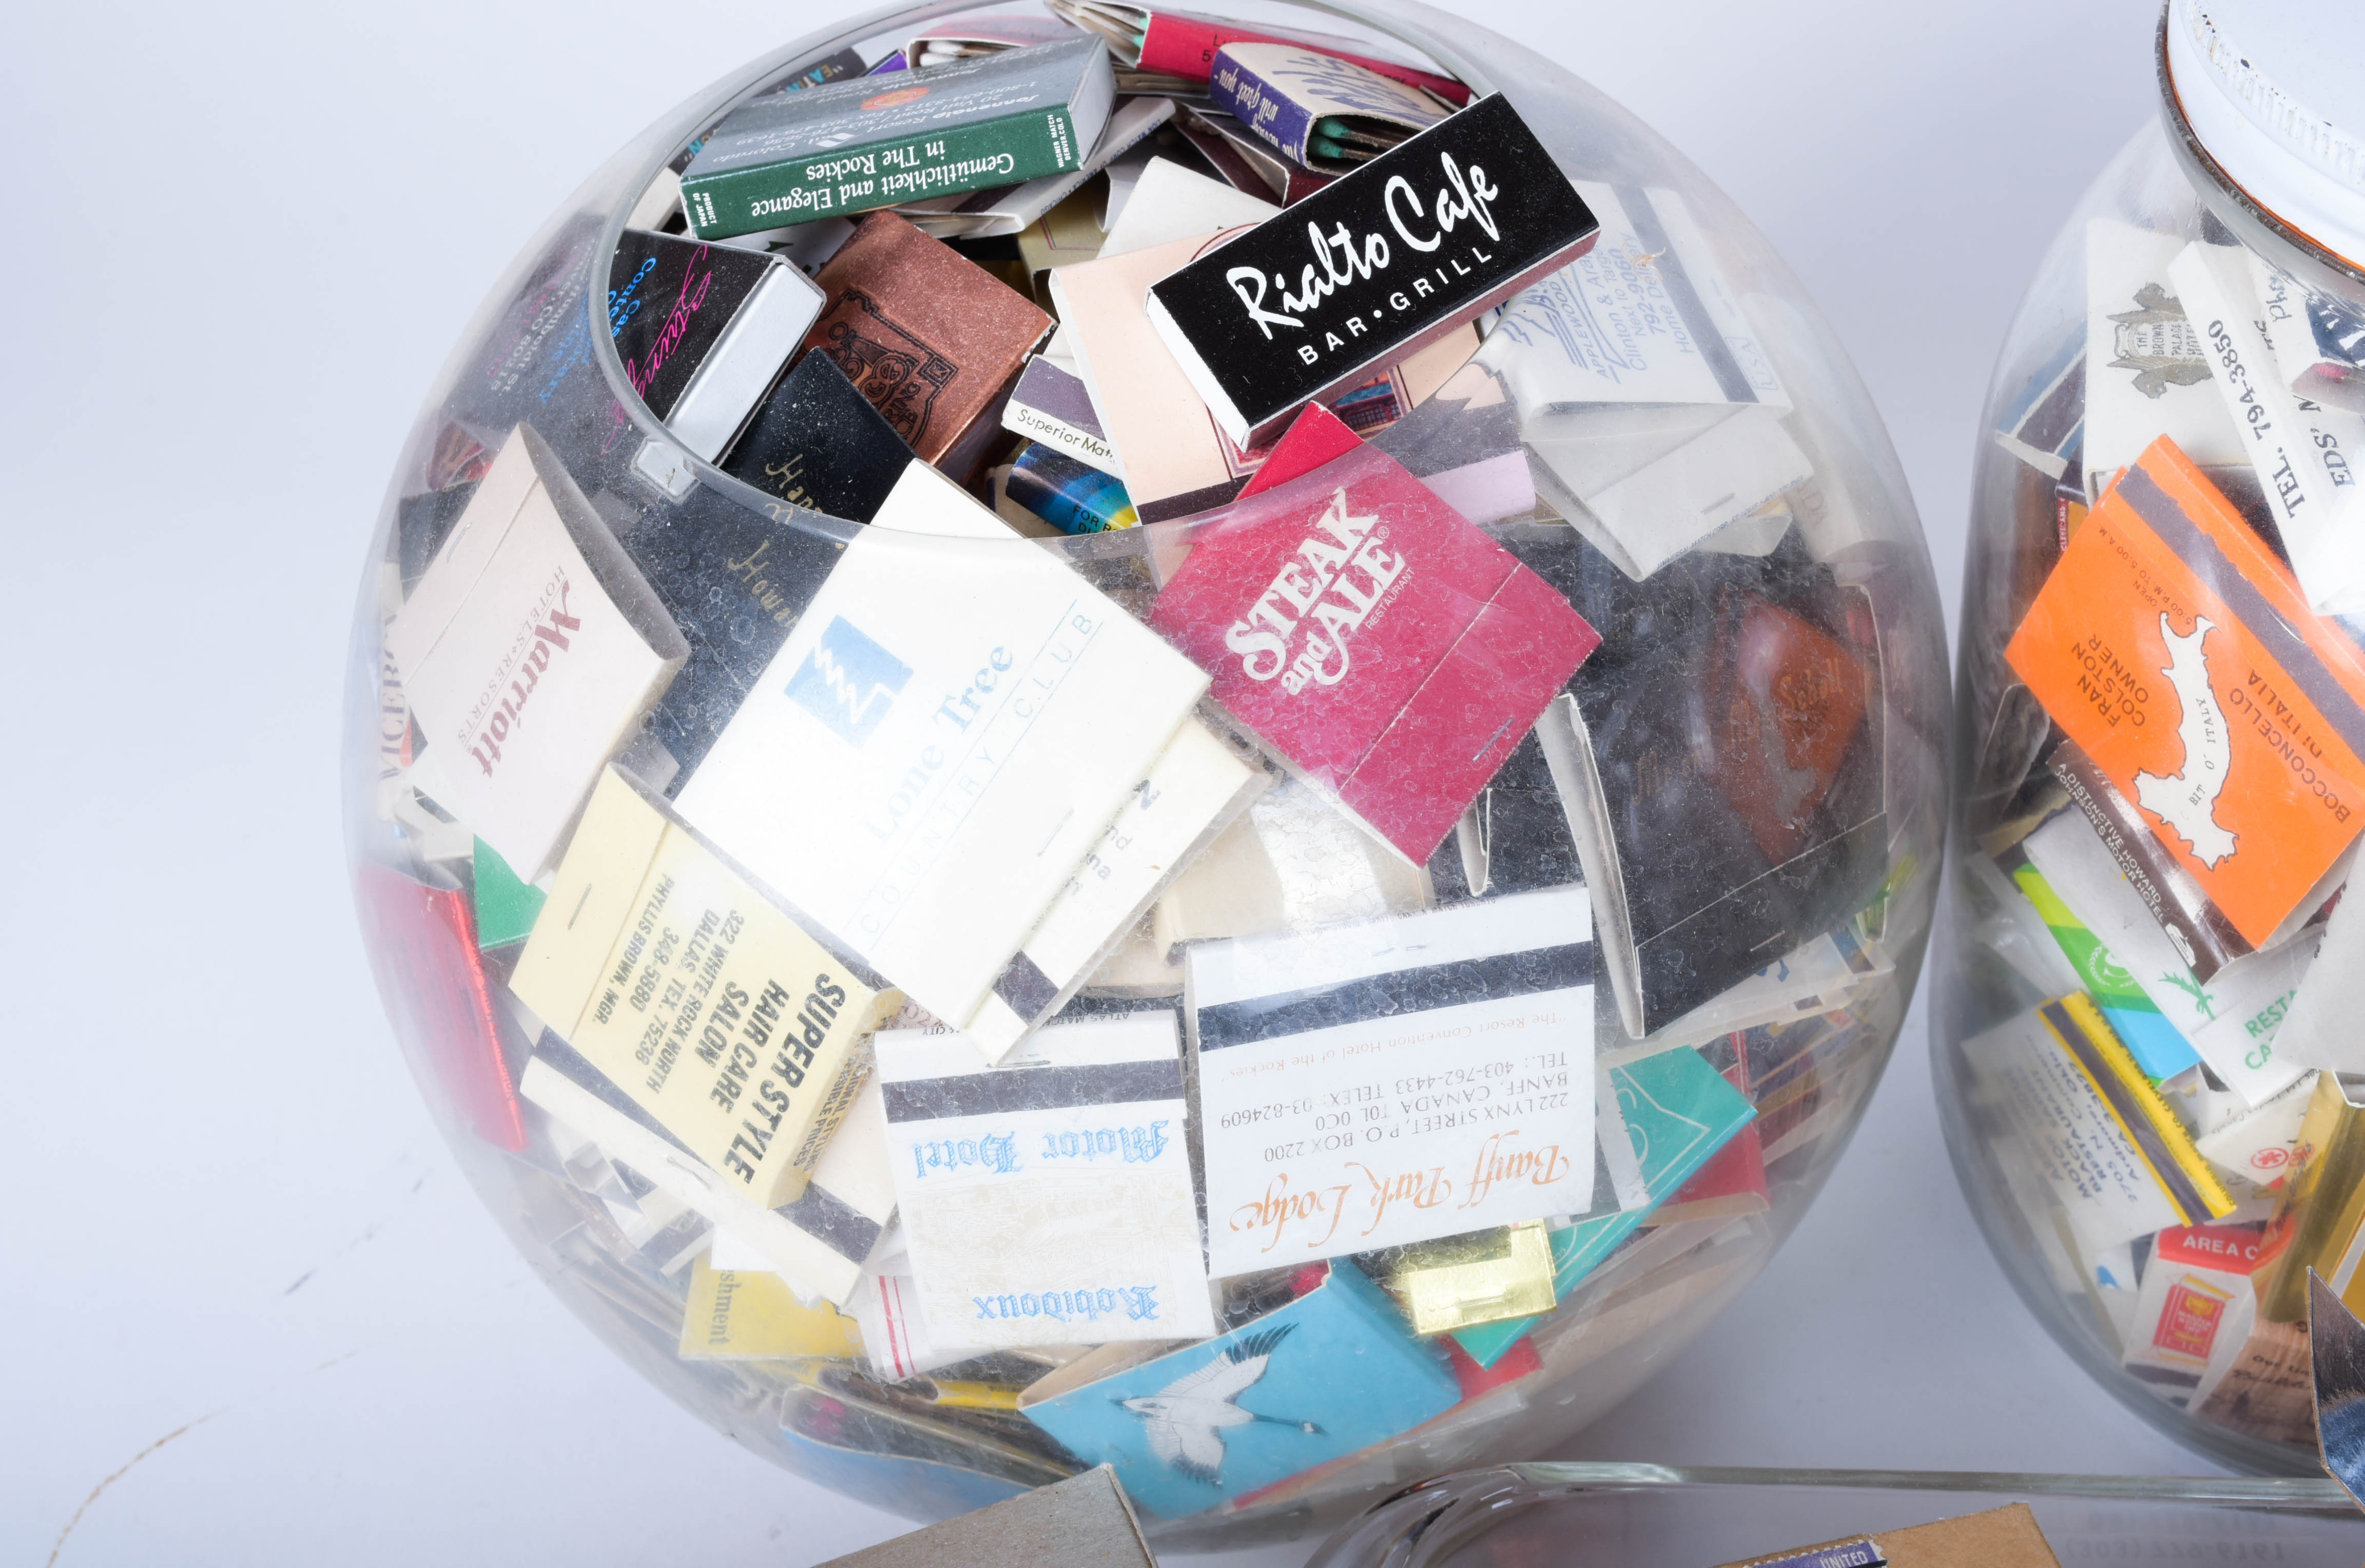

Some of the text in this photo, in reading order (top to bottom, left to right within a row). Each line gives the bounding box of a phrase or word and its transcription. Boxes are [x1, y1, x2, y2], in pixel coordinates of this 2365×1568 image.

[941, 100, 973, 110] Vail
[712, 142, 796, 164] Colorado
[805, 140, 946, 184] in The Rockies
[1047, 114, 1064, 168] WAGNER MATCH
[1125, 129, 1147, 149] MATCH
[750, 151, 1015, 217] Gemütlichkeit and Elegance
[1039, 190, 1068, 216] CHICAGO
[1072, 167, 1098, 191] AMERICA
[692, 192, 708, 226] OF JAPAN
[702, 192, 717, 224] PRODUCT
[1227, 151, 1500, 340] Rialto Cafe
[1298, 247, 1492, 366] BAR GRILL
[1594, 246, 1647, 336] Next to Targe
[1609, 248, 1667, 334] 792-9060
[1549, 282, 1610, 377] APPLEWOOD
[1600, 293, 1649, 369] Clinton &
[1660, 306, 1694, 352] Home
[2137, 330, 2148, 348] THE
[2151, 323, 2165, 356] BROWN
[2204, 318, 2275, 441] 794-3850
[1016, 407, 1080, 446] Superior
[2271, 446, 2309, 517] TEL.
[1072, 504, 1099, 527] FOR
[2115, 545, 2139, 569] 5:00
[2137, 569, 2153, 584] TO
[1225, 486, 1379, 681] STEAK
[1364, 567, 1415, 629] RESTAURANT
[2131, 580, 2159, 607] OPEN
[1281, 537, 1406, 696] and ALE
[2169, 601, 2193, 625] 5:00
[456, 564, 567, 742] HOTELS RESORTS
[2081, 633, 2155, 705] OWNER
[472, 579, 580, 778] Marriott
[2064, 641, 2153, 728] COLSTON
[2071, 674, 2126, 728] FRAN
[2239, 668, 2308, 735] ITALIA
[2195, 696, 2217, 743] ITALY
[864, 644, 1014, 844] Lone Tree
[2228, 687, 2351, 824] BOCCONCELLO
[860, 613, 1093, 935] COUNTRY CLUB
[2188, 783, 2207, 806] BIT
[2053, 767, 2167, 923] JOHNSON'S MOTOR HOTEL
[2058, 761, 2164, 904] A DISTINCTIVE HOWARD
[591, 872, 675, 1027] PHYLLIS BROWN, MGR.
[627, 925, 681, 1013] 348-5880
[644, 908, 745, 1094] 322 WHITE ROCK NORTH
[658, 977, 687, 1014] TEX.
[1090, 1011, 1130, 1023] ATLAS
[2244, 989, 2298, 1038] RESTA
[633, 1013, 668, 1066] 75238
[693, 980, 752, 1069] SALON
[708, 978, 791, 1114] HAIR CARE
[769, 970, 849, 1090] SUPER
[920, 1025, 947, 1037] CITY
[1387, 1024, 1472, 1050] Convention
[1478, 1016, 1525, 1036] Resort
[1290, 1053, 1314, 1068] the
[1341, 1041, 1382, 1060] Hotel
[1394, 1059, 1516, 1095] 403-762-4433
[1400, 1070, 1569, 1114] BANFF, CANADA
[1538, 1091, 1570, 1111] 222
[722, 1077, 792, 1184] STYLE
[1218, 1096, 1312, 1129] 03-824609
[1404, 1107, 1479, 1135] STREET,
[1483, 1097, 1534, 1121] LYNX
[2029, 1067, 2107, 1180] RESTAURANT
[792, 1119, 827, 1165] PRICES
[910, 1120, 1171, 1179] Motor Hotel
[1263, 1140, 1307, 1163] 2200
[1309, 1130, 1355, 1153] BOX
[2061, 1136, 2103, 1192] BLACK
[2044, 1133, 2093, 1200] MOTOR
[1229, 1129, 1570, 1253] Banff Park Lodge
[2182, 1233, 2240, 1258] AREA
[972, 1285, 1159, 1329] Robidoux
[1819, 1551, 1868, 1568] UNITED
